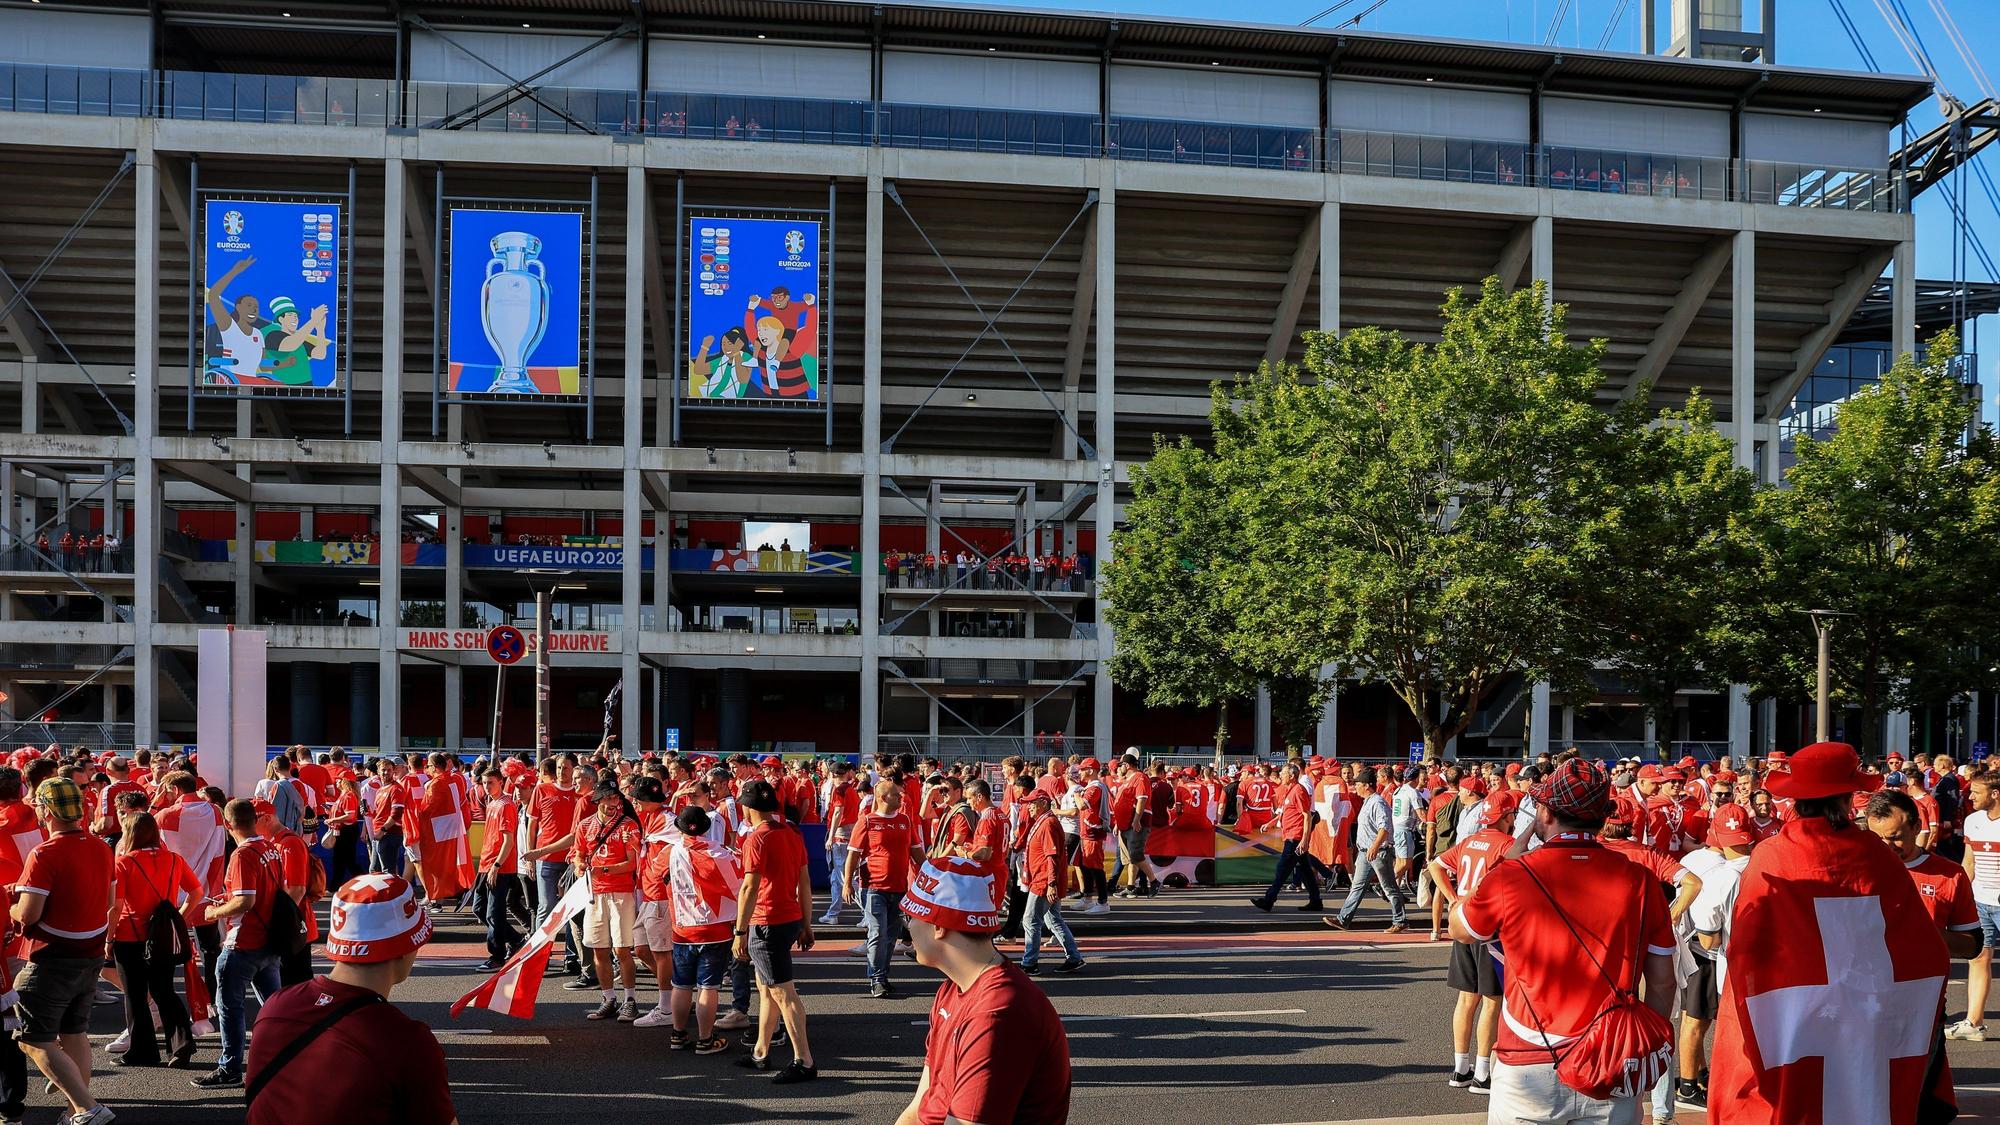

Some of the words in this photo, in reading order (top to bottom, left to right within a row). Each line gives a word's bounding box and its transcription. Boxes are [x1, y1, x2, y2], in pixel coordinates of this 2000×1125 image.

[778, 260, 811, 268] EURO2024
[596, 551, 625, 565] 202
[408, 631, 449, 649] HANS
[528, 632, 609, 652] SDKURVE
[1191, 788, 1201, 808] 3
[1251, 783, 1271, 803] 22
[906, 900, 932, 917] HOPP
[966, 914, 999, 928] SCH
[326, 939, 370, 957] WEIZ
